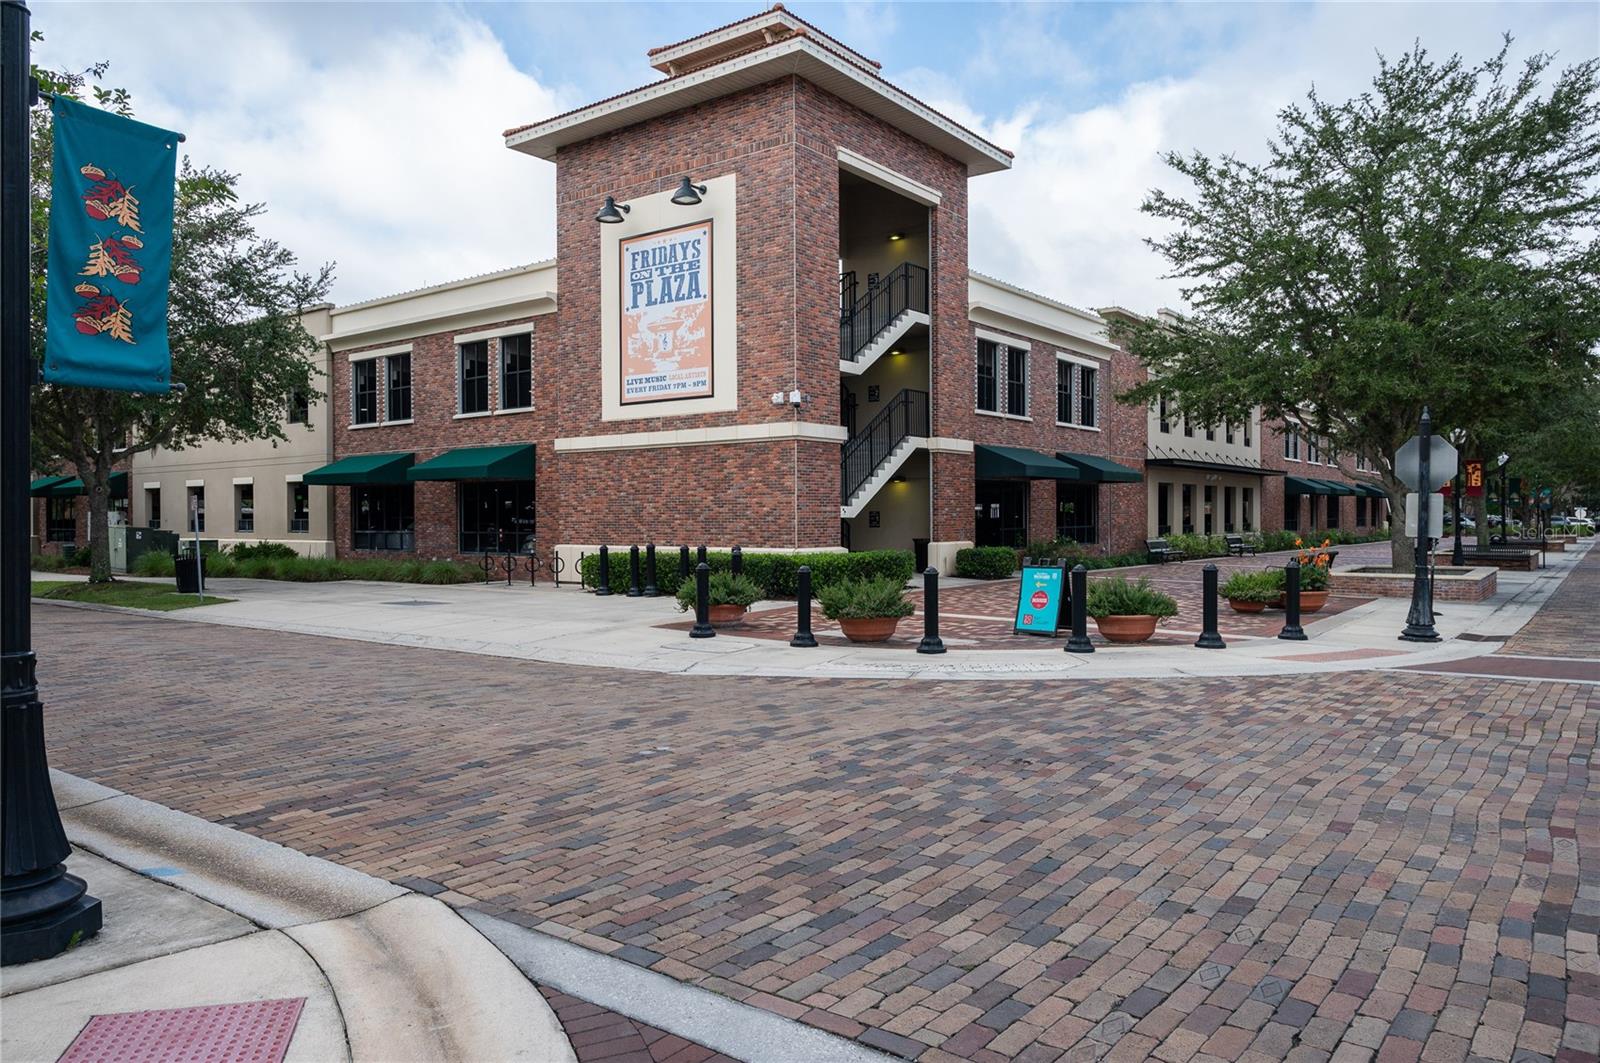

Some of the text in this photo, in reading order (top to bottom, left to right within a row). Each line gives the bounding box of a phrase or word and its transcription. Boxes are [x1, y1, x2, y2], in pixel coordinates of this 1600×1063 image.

[631, 239, 701, 271] FRIDAYS
[631, 259, 701, 281] ON THE
[631, 271, 702, 309] PLAZA
[626, 377, 644, 386] LIVE
[644, 375, 667, 385] MUSIC
[626, 386, 648, 395] EVERY
[648, 383, 672, 393] FRIDAY
[673, 382, 687, 390] 7PM
